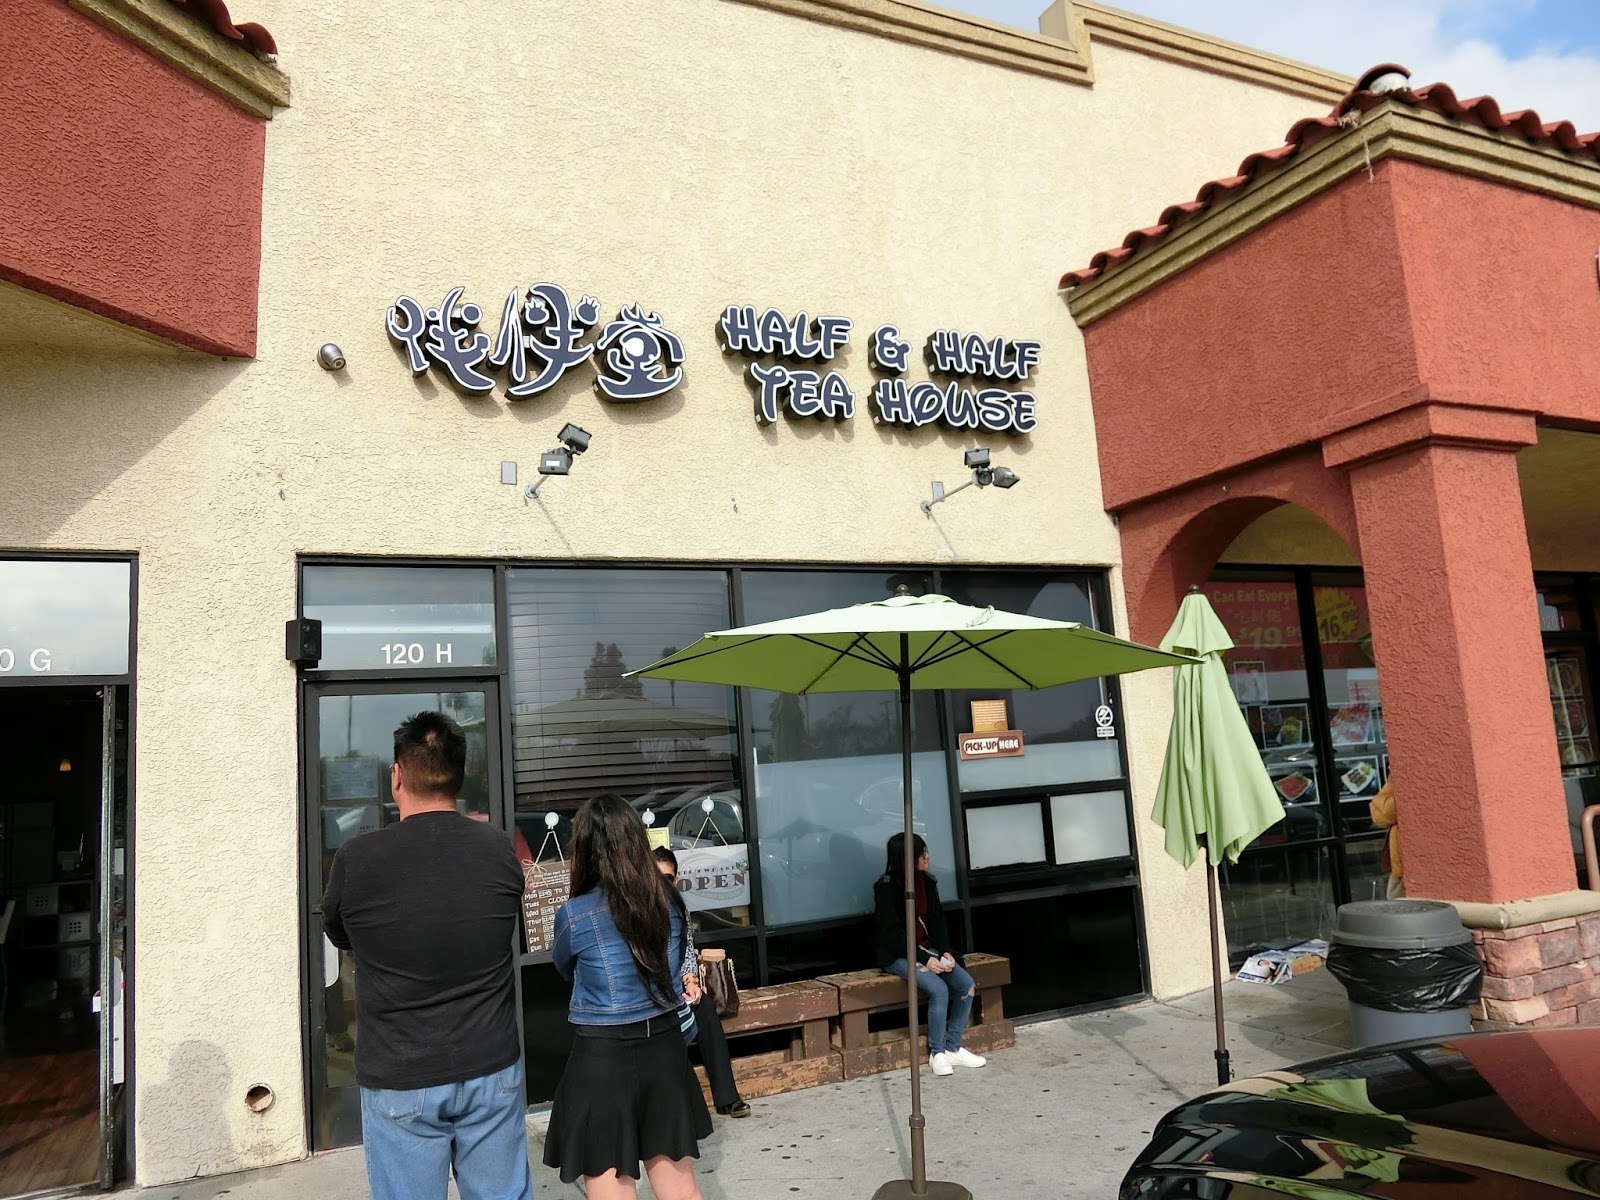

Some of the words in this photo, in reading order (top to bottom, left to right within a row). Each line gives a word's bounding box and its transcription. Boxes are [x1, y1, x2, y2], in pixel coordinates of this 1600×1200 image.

[722, 304, 854, 360] HALF
[872, 323, 913, 373] &
[931, 327, 1043, 381] HALF
[749, 362, 856, 425] TEA
[874, 378, 1040, 434] HOUSE
[1258, 589, 1297, 609] Everyd
[29, 648, 52, 672] G
[380, 643, 425, 665] 120
[435, 643, 453, 664] H
[965, 739, 997, 752] PICK-UP
[998, 738, 1019, 750] HERE
[676, 872, 746, 893] OPEN
